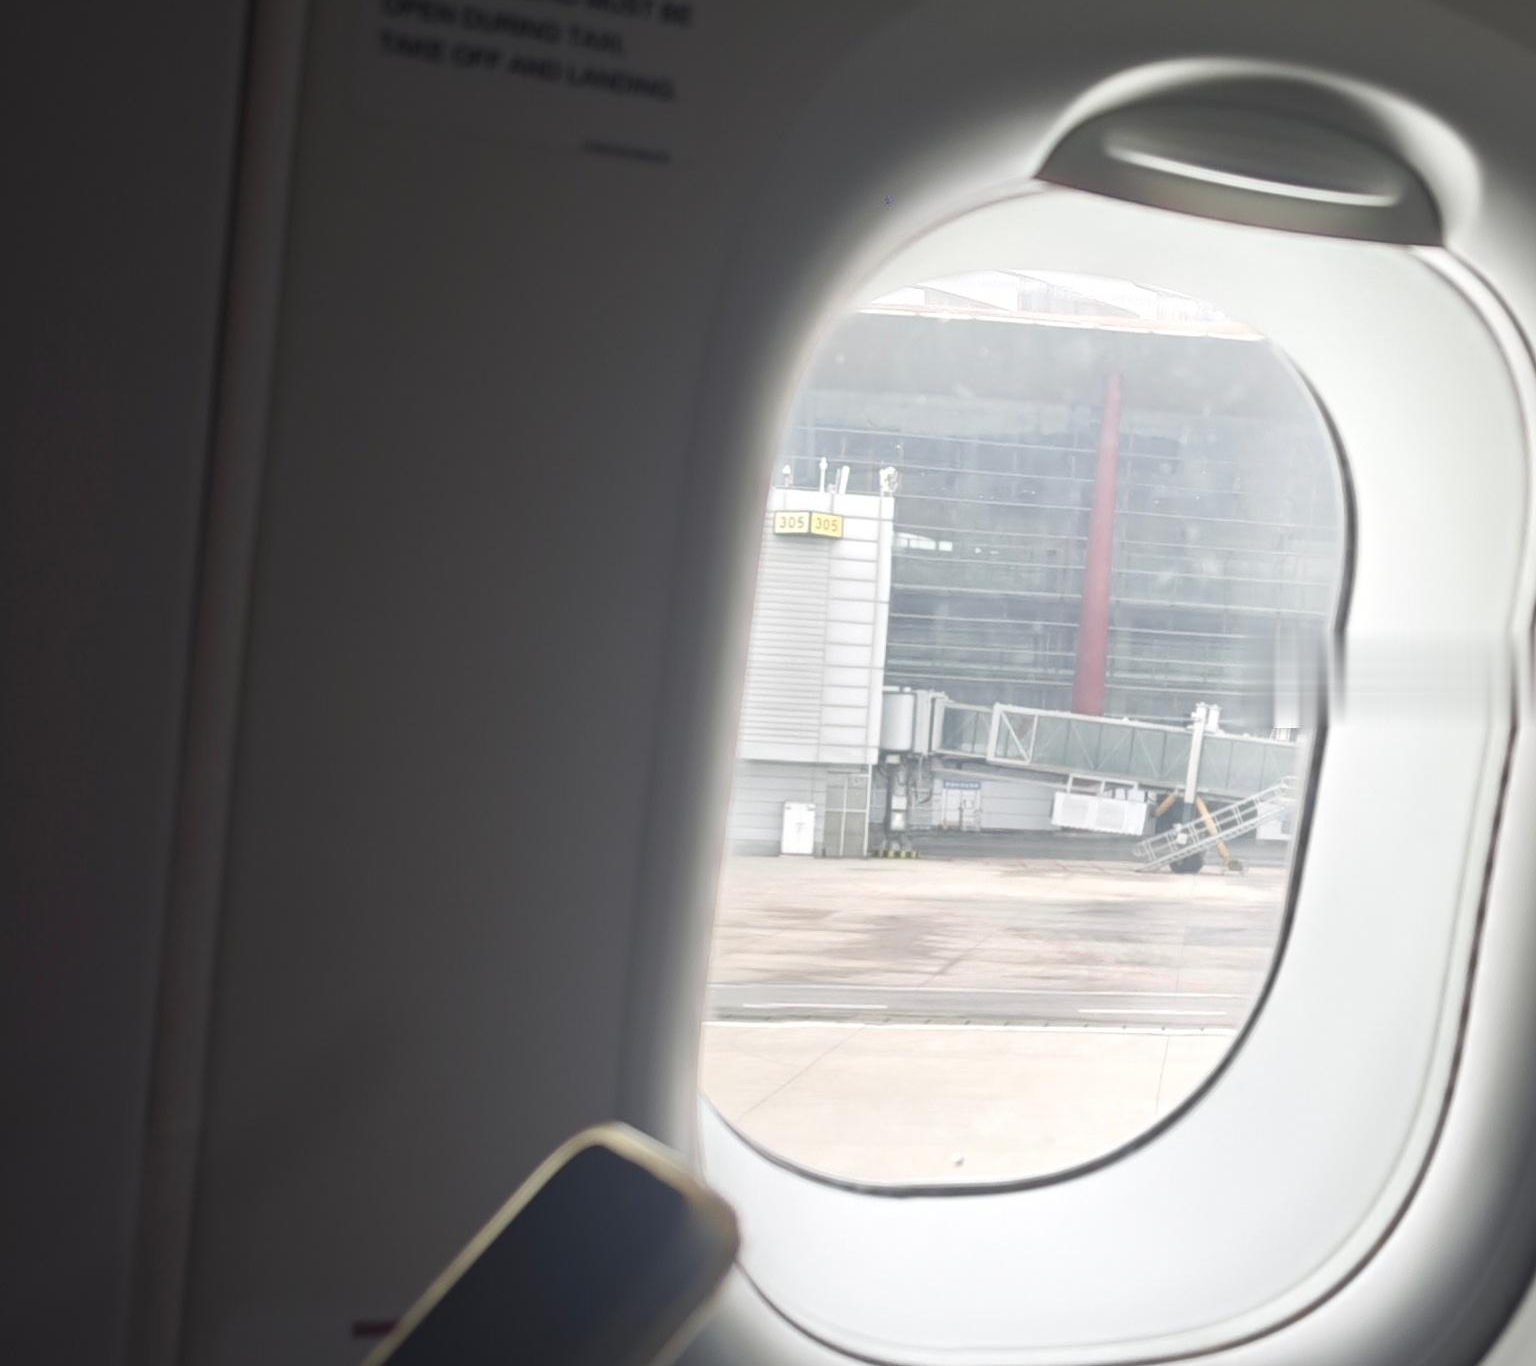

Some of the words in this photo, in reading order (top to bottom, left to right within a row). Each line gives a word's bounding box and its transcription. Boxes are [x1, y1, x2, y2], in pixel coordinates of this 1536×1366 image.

[459, 5, 562, 45] DURING
[658, 0, 694, 29] BE
[377, 27, 446, 65] TAKE
[449, 41, 502, 71] OFF
[507, 53, 563, 85] AND
[779, 516, 805, 529] 305
[815, 517, 839, 532] 305
